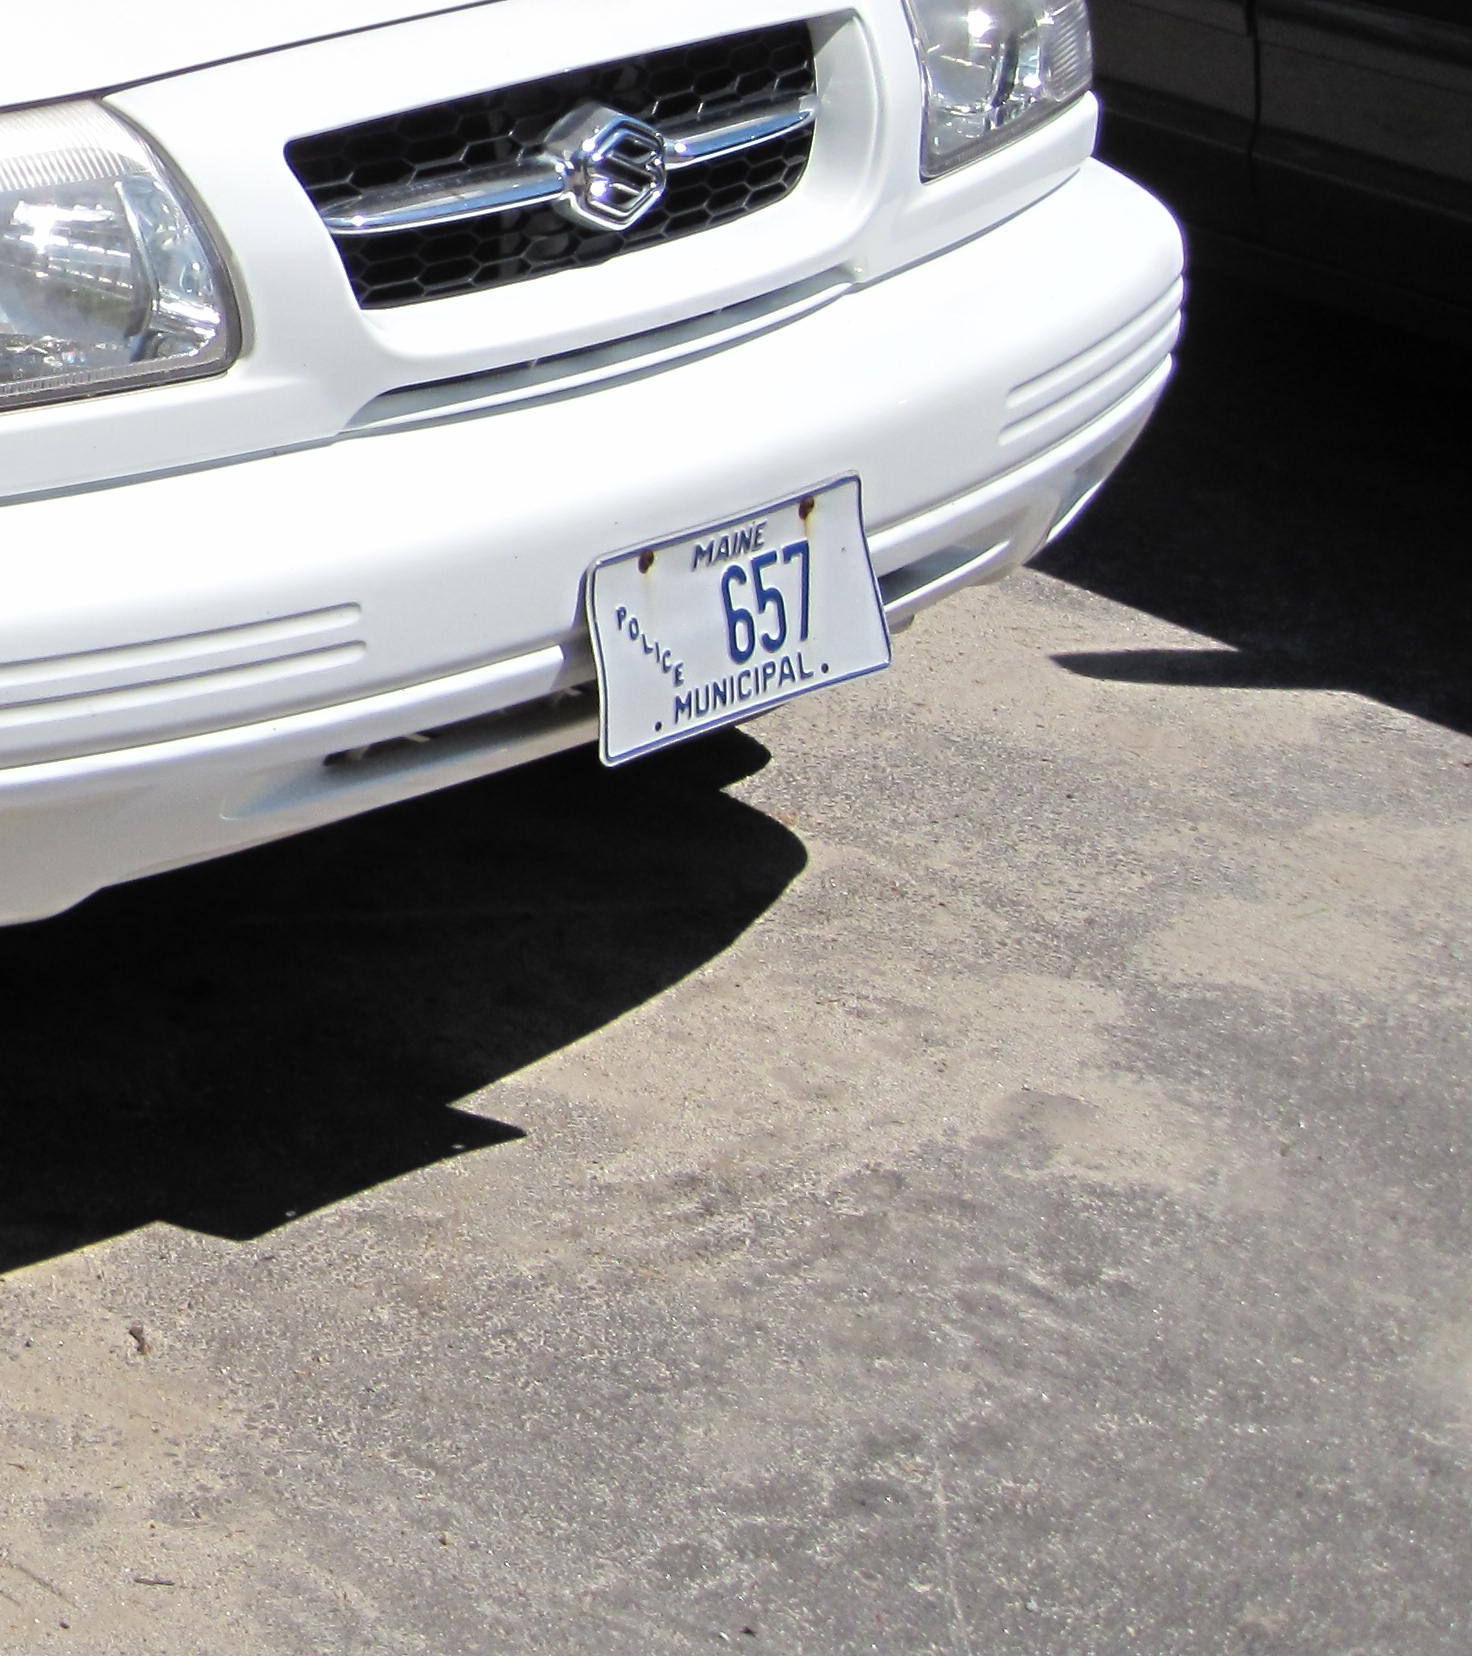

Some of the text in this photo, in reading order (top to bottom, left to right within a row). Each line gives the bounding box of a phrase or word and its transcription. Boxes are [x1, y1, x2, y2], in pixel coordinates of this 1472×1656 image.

[691, 519, 768, 571] MAINE
[721, 539, 811, 664] 657
[615, 605, 685, 687] POLICE
[673, 651, 815, 724] MUNICIPAL
